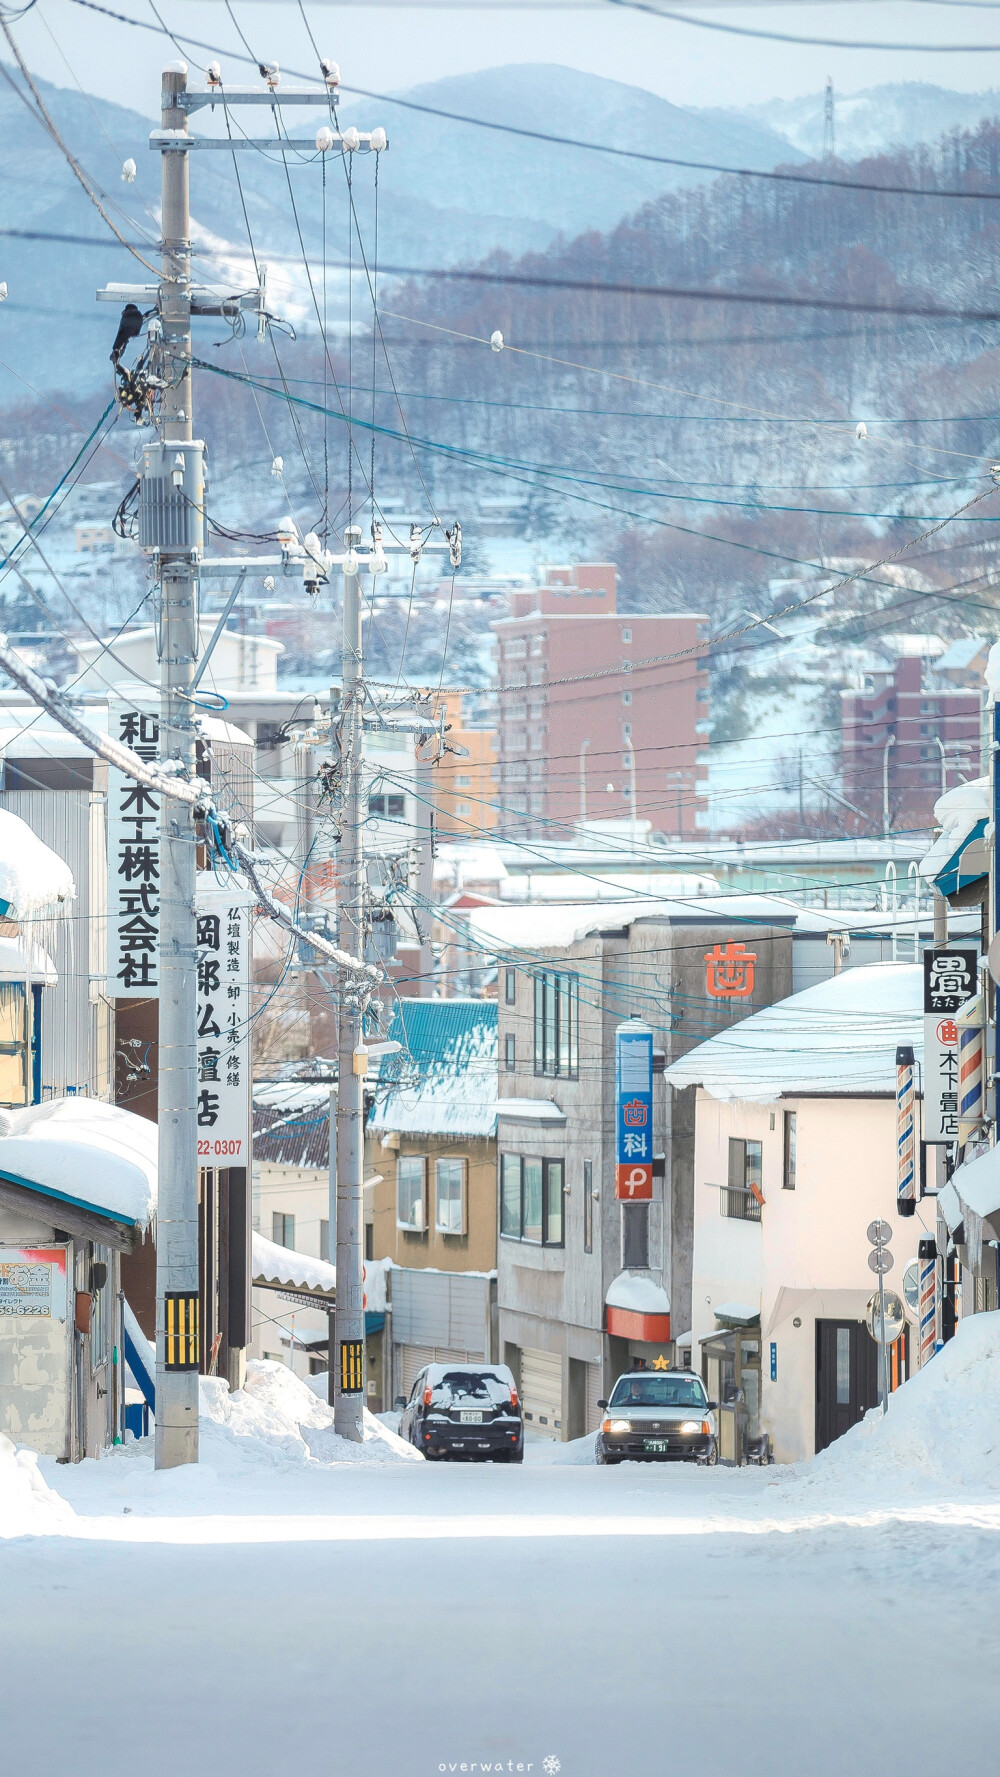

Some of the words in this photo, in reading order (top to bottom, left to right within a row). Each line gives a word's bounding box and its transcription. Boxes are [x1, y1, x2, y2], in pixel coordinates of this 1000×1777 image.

[703, 938, 757, 997] 歯
[929, 956, 971, 997] 畳
[939, 1050, 958, 1135] 木下畳店
[9, 1264, 50, 1287] お金
